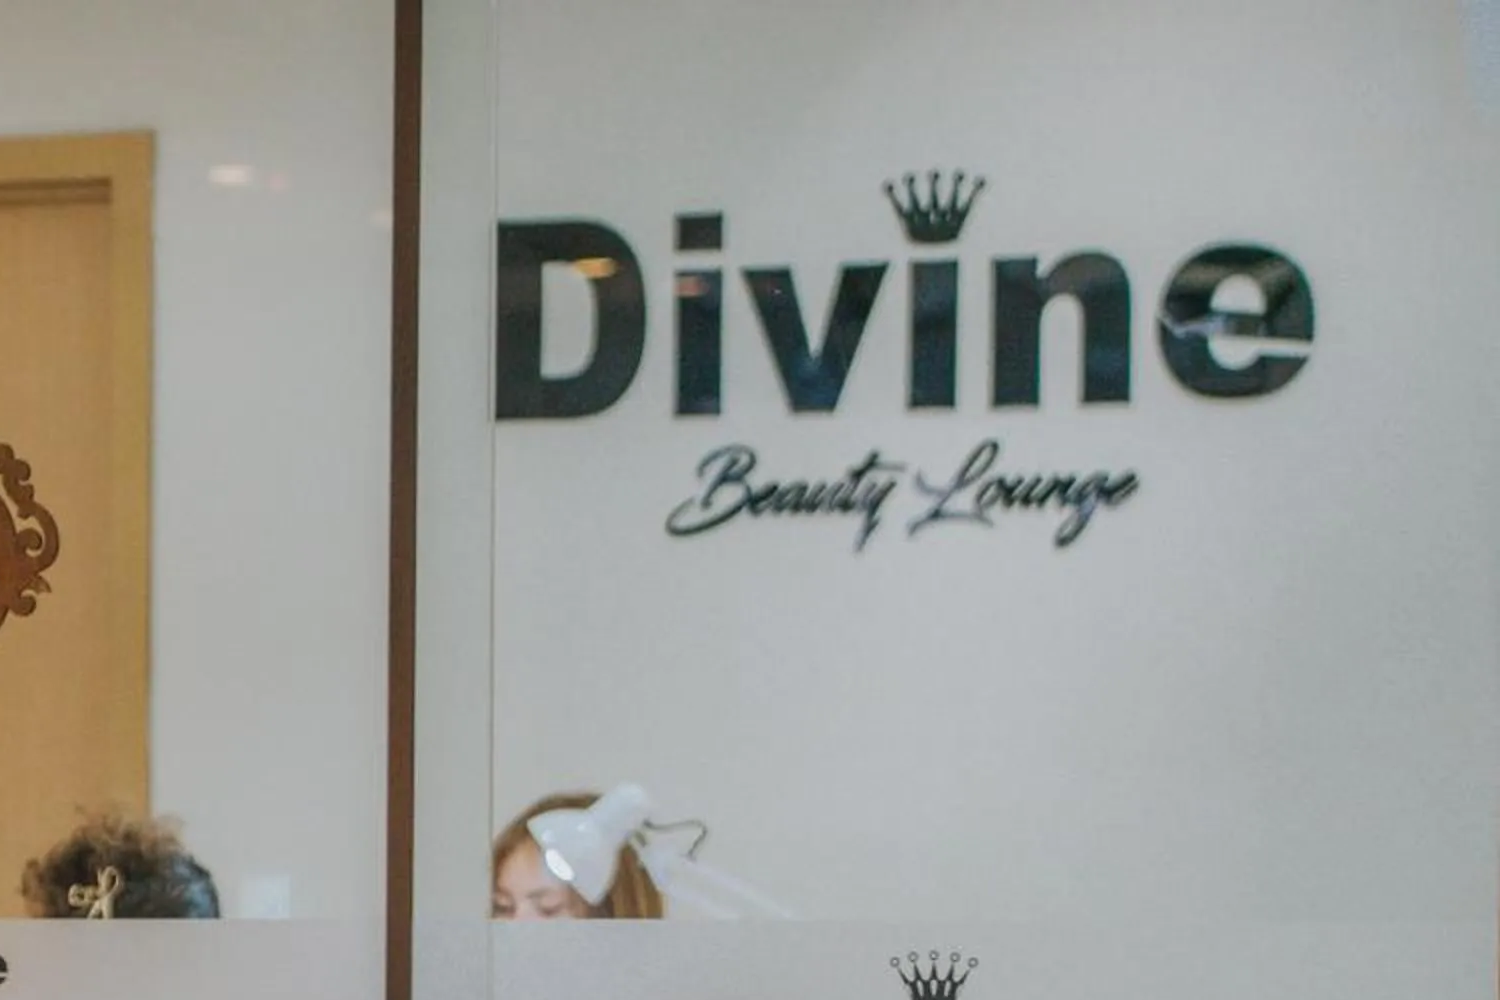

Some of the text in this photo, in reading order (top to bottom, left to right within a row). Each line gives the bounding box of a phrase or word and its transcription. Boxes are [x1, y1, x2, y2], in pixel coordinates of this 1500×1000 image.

[494, 168, 1315, 421] Divine
[666, 438, 1140, 552] Beauty Lounge
